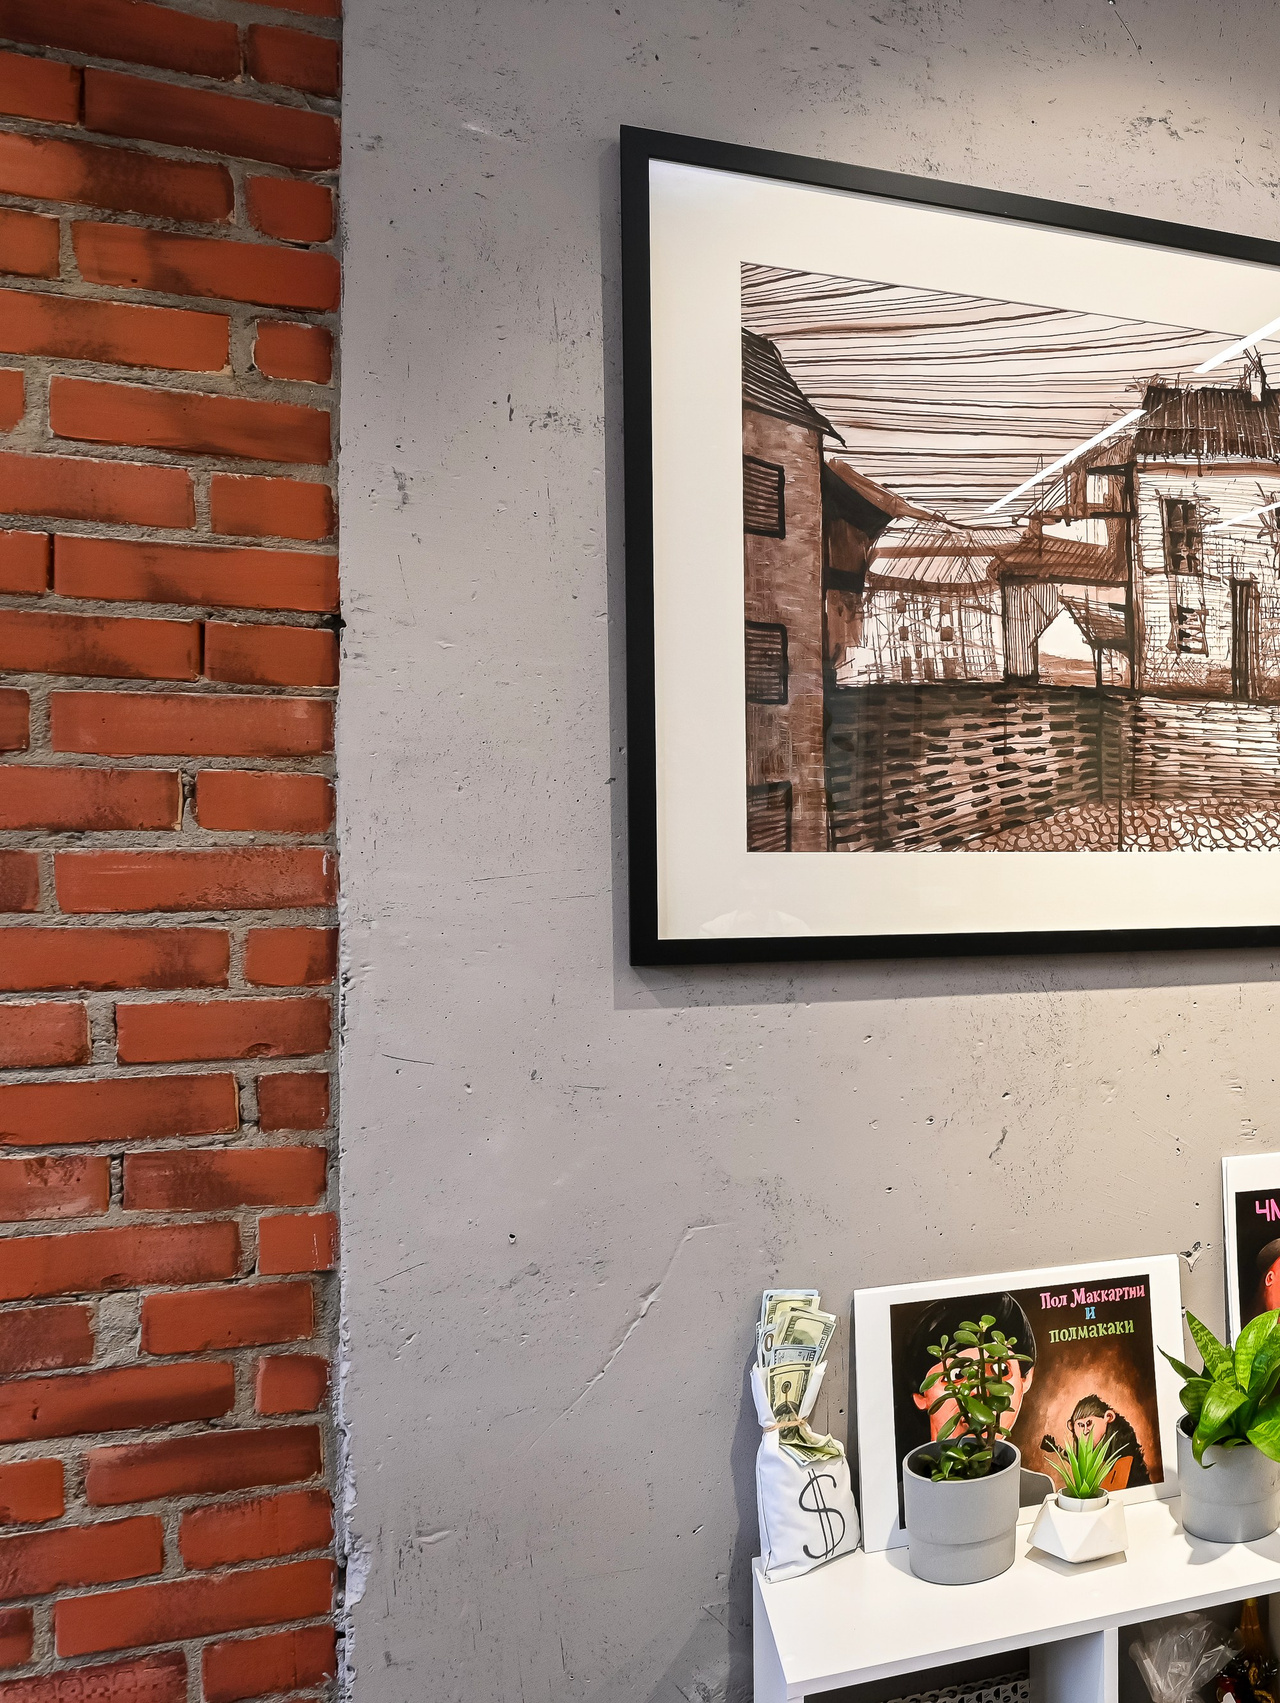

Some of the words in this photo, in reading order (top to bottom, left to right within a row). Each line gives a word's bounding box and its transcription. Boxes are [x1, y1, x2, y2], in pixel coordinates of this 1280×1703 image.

[1040, 1292, 1068, 1310] Пол
[1070, 1284, 1146, 1308] Маккартни
[1048, 1320, 1135, 1343] полмакаки
